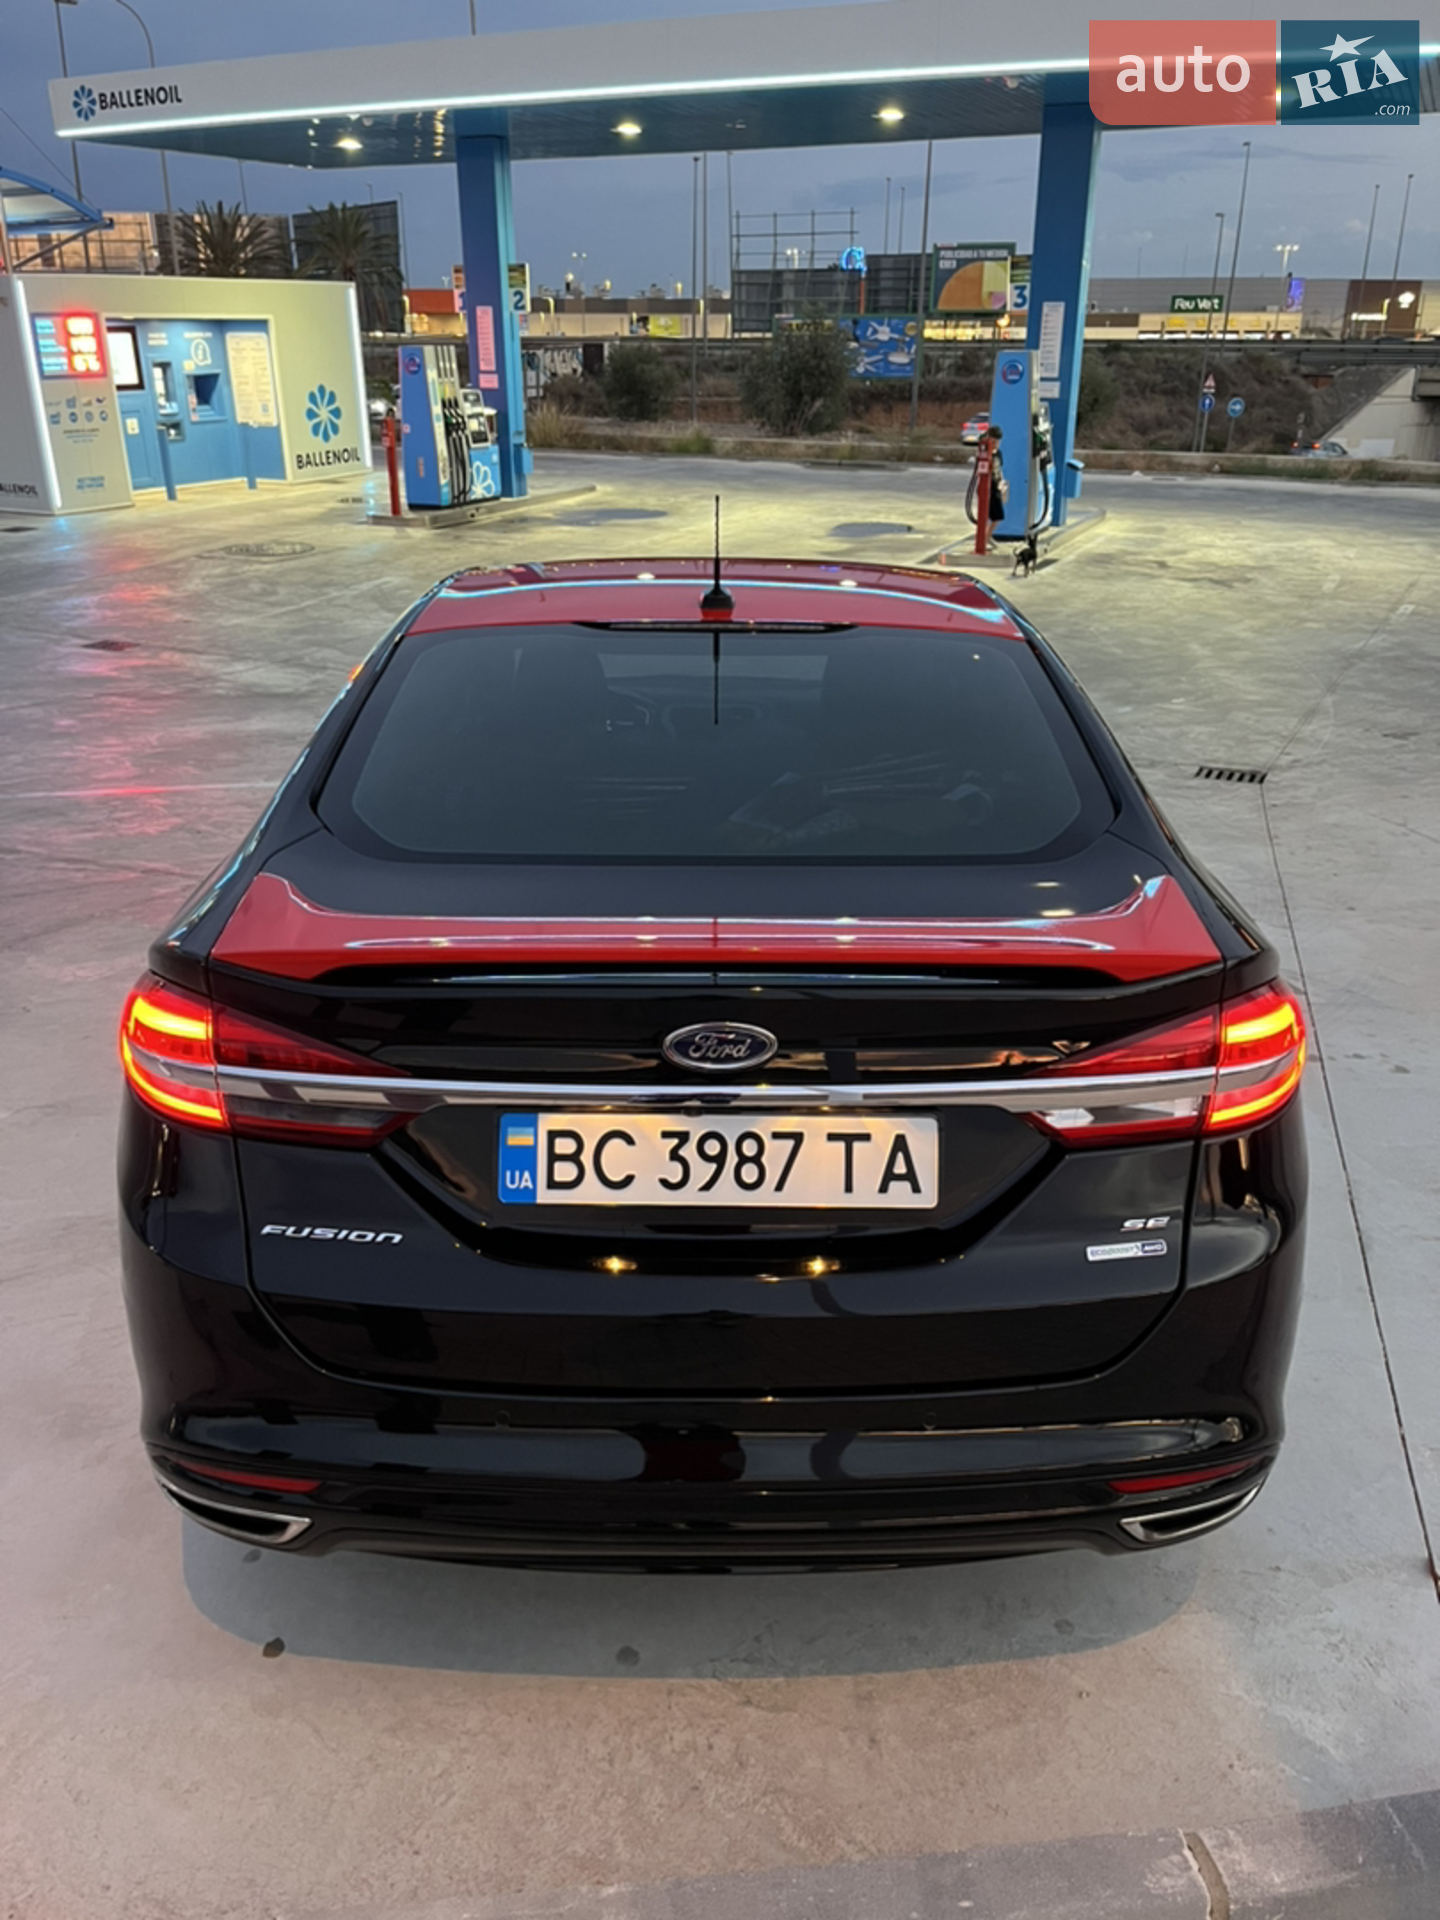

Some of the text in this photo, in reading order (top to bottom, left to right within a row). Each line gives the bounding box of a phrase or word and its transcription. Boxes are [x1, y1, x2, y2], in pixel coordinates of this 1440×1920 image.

[98, 84, 183, 111] BALLENOIL
[513, 290, 526, 310] 2
[1013, 284, 1028, 308] 3
[1174, 298, 1219, 310] Feu Vet
[296, 447, 361, 470] BALLENOIL
[0, 483, 38, 496] ALLENOIL
[688, 1032, 751, 1058] Ford
[545, 1129, 922, 1194] BC 3987 TA
[505, 1170, 533, 1190] UA
[260, 1224, 403, 1244] FUSION
[1120, 1216, 1171, 1232] SE
